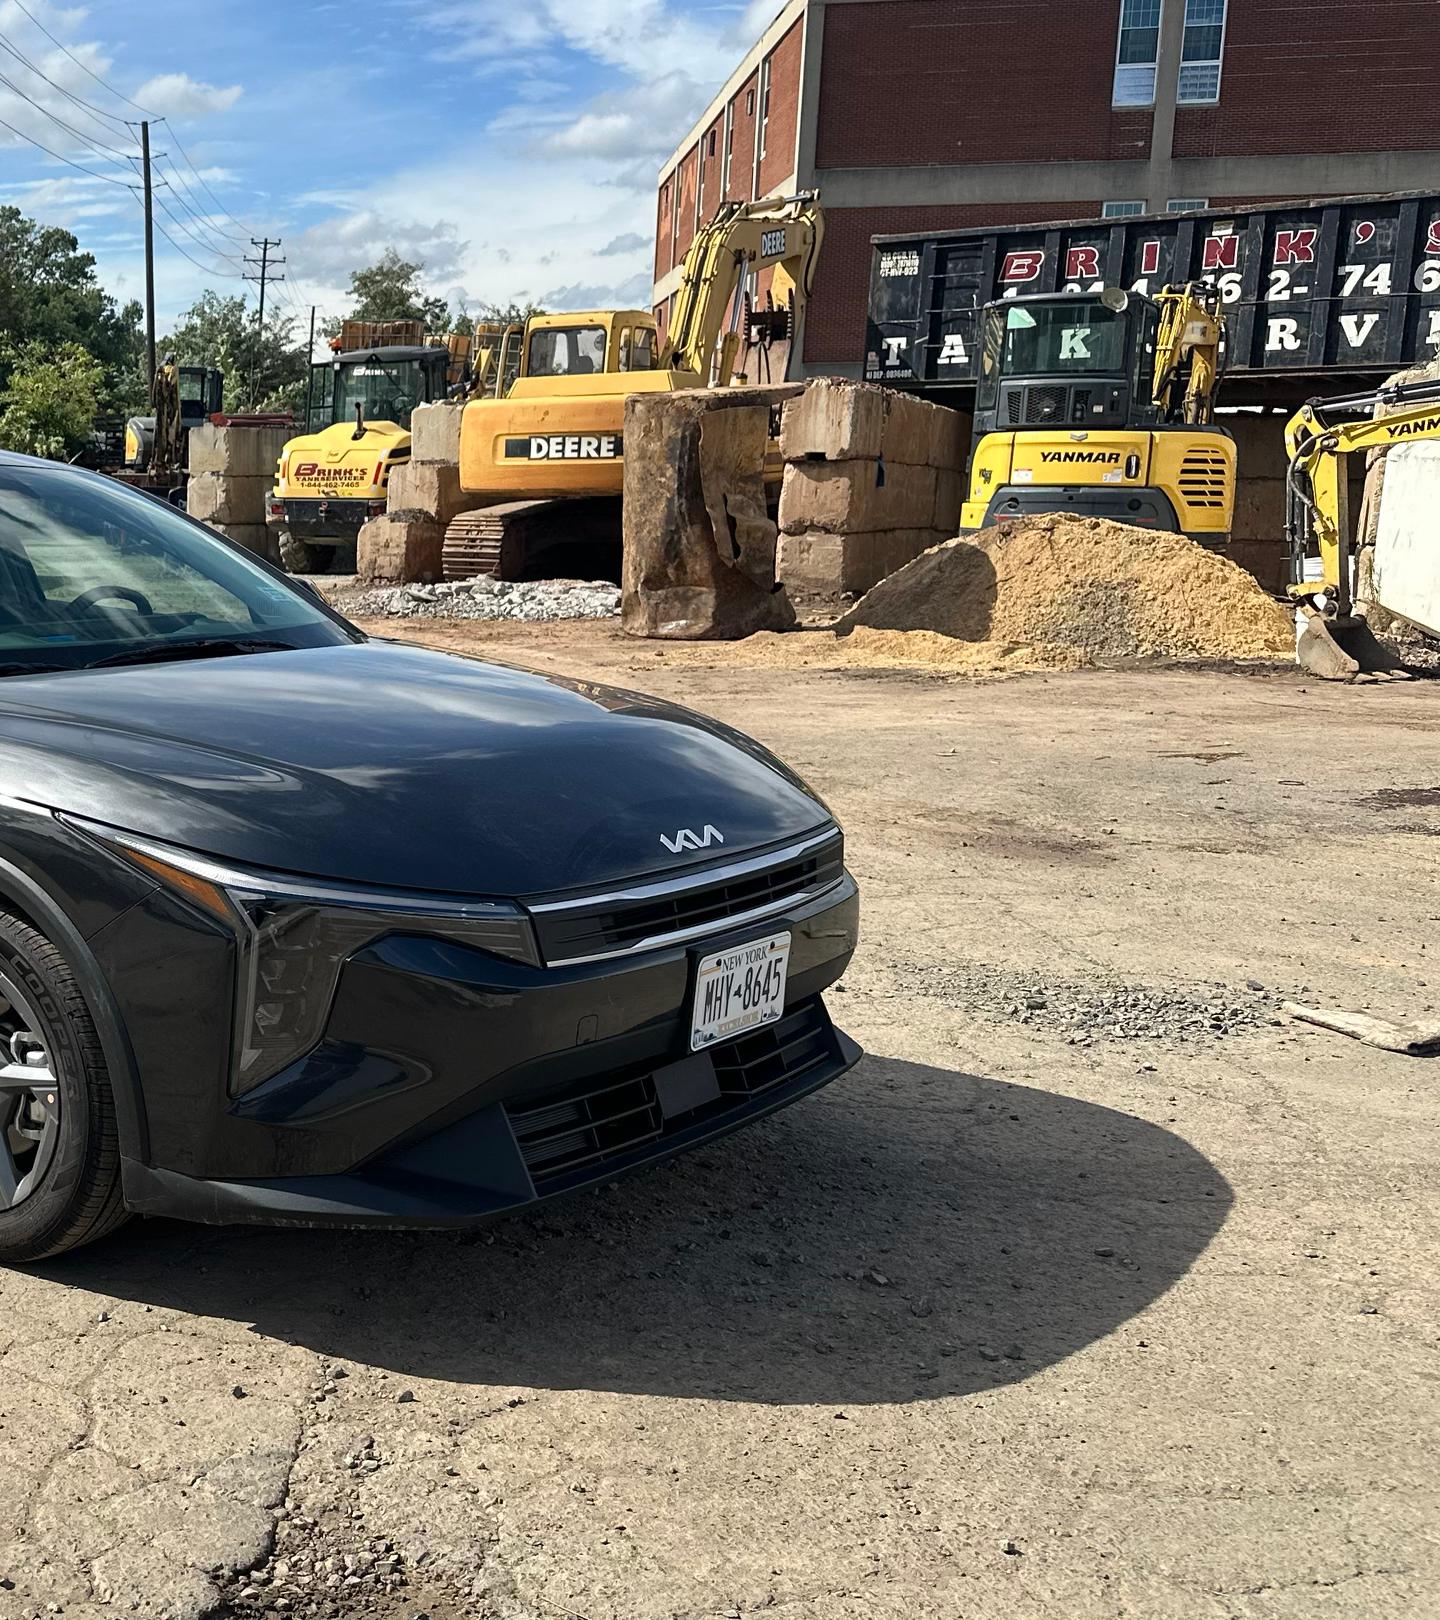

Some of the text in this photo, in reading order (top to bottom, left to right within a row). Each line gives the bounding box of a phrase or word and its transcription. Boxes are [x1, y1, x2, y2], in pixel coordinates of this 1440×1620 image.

[762, 230, 785, 256] DEERE
[530, 436, 615, 459] DEERE
[1041, 452, 1120, 463] YANMAR
[294, 463, 367, 477] BRINK'S
[660, 825, 724, 853] KIA
[721, 945, 768, 973] NEW YORK
